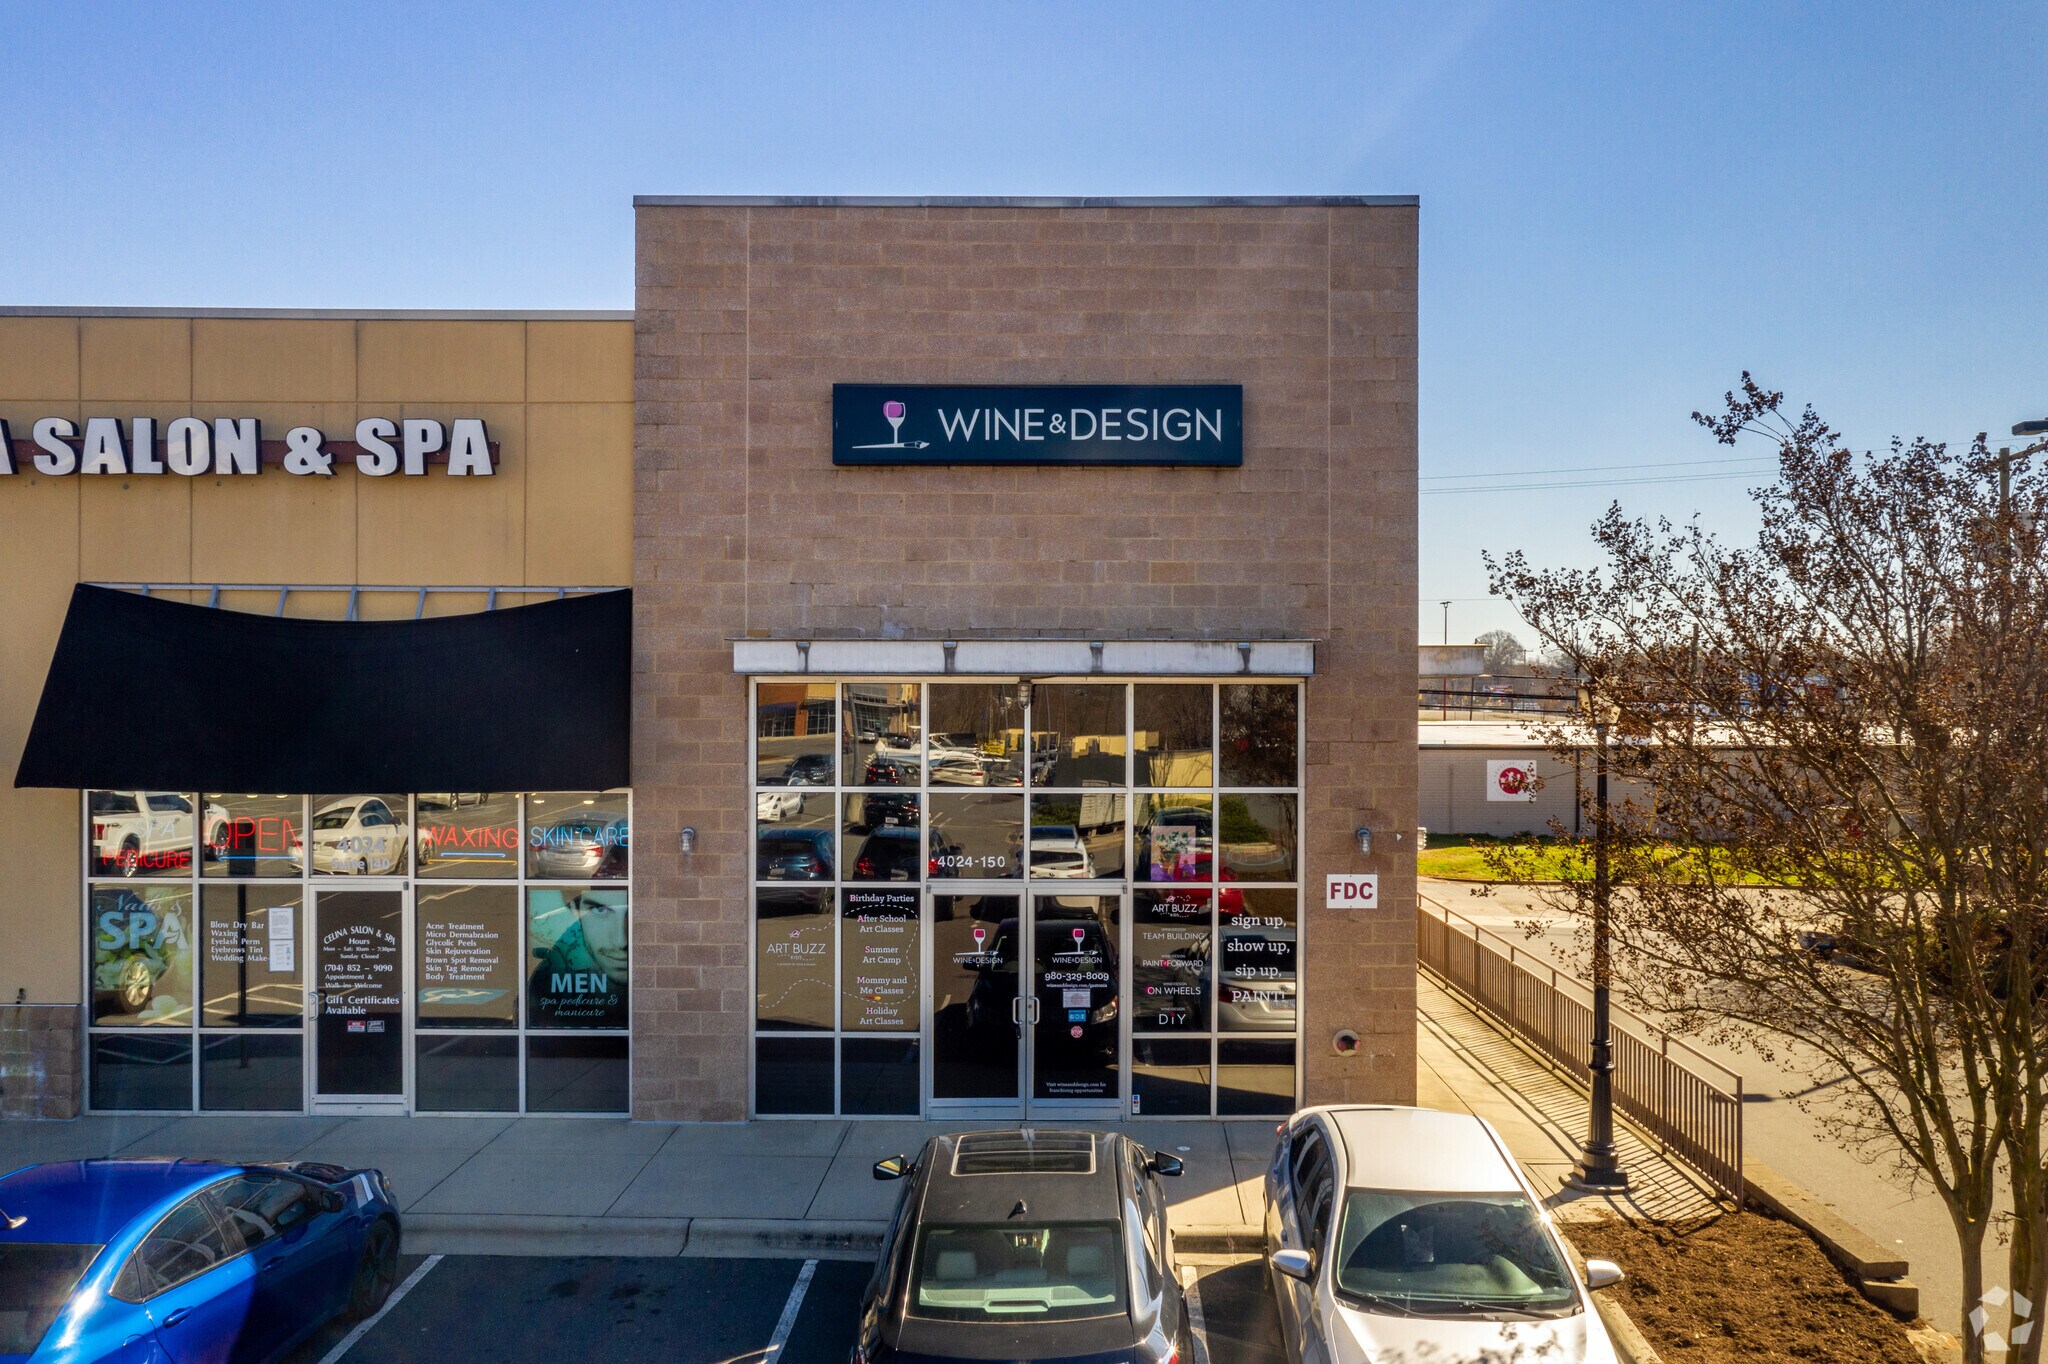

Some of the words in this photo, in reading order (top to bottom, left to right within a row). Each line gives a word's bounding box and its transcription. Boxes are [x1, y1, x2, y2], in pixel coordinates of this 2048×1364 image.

[33, 417, 262, 476] SALON
[284, 426, 337, 476] &
[356, 418, 496, 477] SPA
[423, 826, 518, 849] WAXING
[530, 826, 573, 848] SKIN
[579, 826, 629, 848] CARE
[336, 836, 386, 853] 4024
[102, 848, 191, 869] PEDICURE
[331, 857, 366, 870] Suite
[370, 856, 391, 870] 140
[937, 855, 1006, 868] 4024-150
[1330, 882, 1374, 900] FDC
[849, 894, 885, 904] Birthday
[886, 894, 915, 903] Parties
[1152, 904, 1170, 913] ART
[1172, 904, 1198, 913] BUZZ
[857, 915, 878, 923] After
[879, 914, 907, 923] School
[1231, 914, 1261, 929] sign
[1265, 917, 1287, 928] up,
[210, 920, 230, 929] Blow
[233, 921, 248, 930] Dry
[252, 920, 265, 929] Bar
[449, 922, 485, 930] Treatment
[859, 925, 873, 933] Art
[874, 925, 904, 933] Classes
[99, 912, 189, 949] SPA
[211, 929, 239, 938] Waxing
[323, 928, 348, 944] CELINA
[350, 926, 374, 935] SALON
[375, 929, 383, 938] &
[384, 933, 396, 945] SPA
[449, 931, 499, 939] Dermabrasion
[211, 938, 239, 946] Eyelash
[426, 939, 455, 948] Glycolic
[1227, 938, 1265, 952] show
[1268, 943, 1291, 954] up,
[211, 946, 246, 954] Eyebrows
[766, 943, 789, 954] ART
[793, 943, 826, 954] BUZZ
[865, 945, 899, 954] Summer
[211, 954, 244, 963] Wedding
[451, 957, 467, 965] Spot
[469, 956, 499, 964] Removal
[863, 956, 876, 964] Art
[877, 956, 902, 966] Camp
[324, 964, 344, 972] (704)
[347, 964, 361, 972] 852
[373, 964, 393, 972] 9090
[446, 965, 458, 973] Tag
[1235, 964, 1256, 979] sip
[1260, 967, 1282, 979] up,
[426, 973, 445, 981] Body
[856, 976, 890, 986] Mommy
[892, 976, 908, 984] and
[1044, 971, 1110, 982] 980-329-8009
[551, 973, 607, 993] MEN
[874, 987, 904, 995] Classes
[1148, 987, 1162, 995] ON
[1164, 987, 1201, 995] WHEELS
[325, 995, 343, 1005] Gift
[348, 995, 400, 1005] Certificates
[540, 997, 557, 1009] spa
[559, 994, 605, 1010] pedicure
[325, 1006, 367, 1015] Available
[555, 1007, 606, 1017] manicure
[866, 1007, 898, 1017] Holiday
[874, 1017, 904, 1025] Classes
